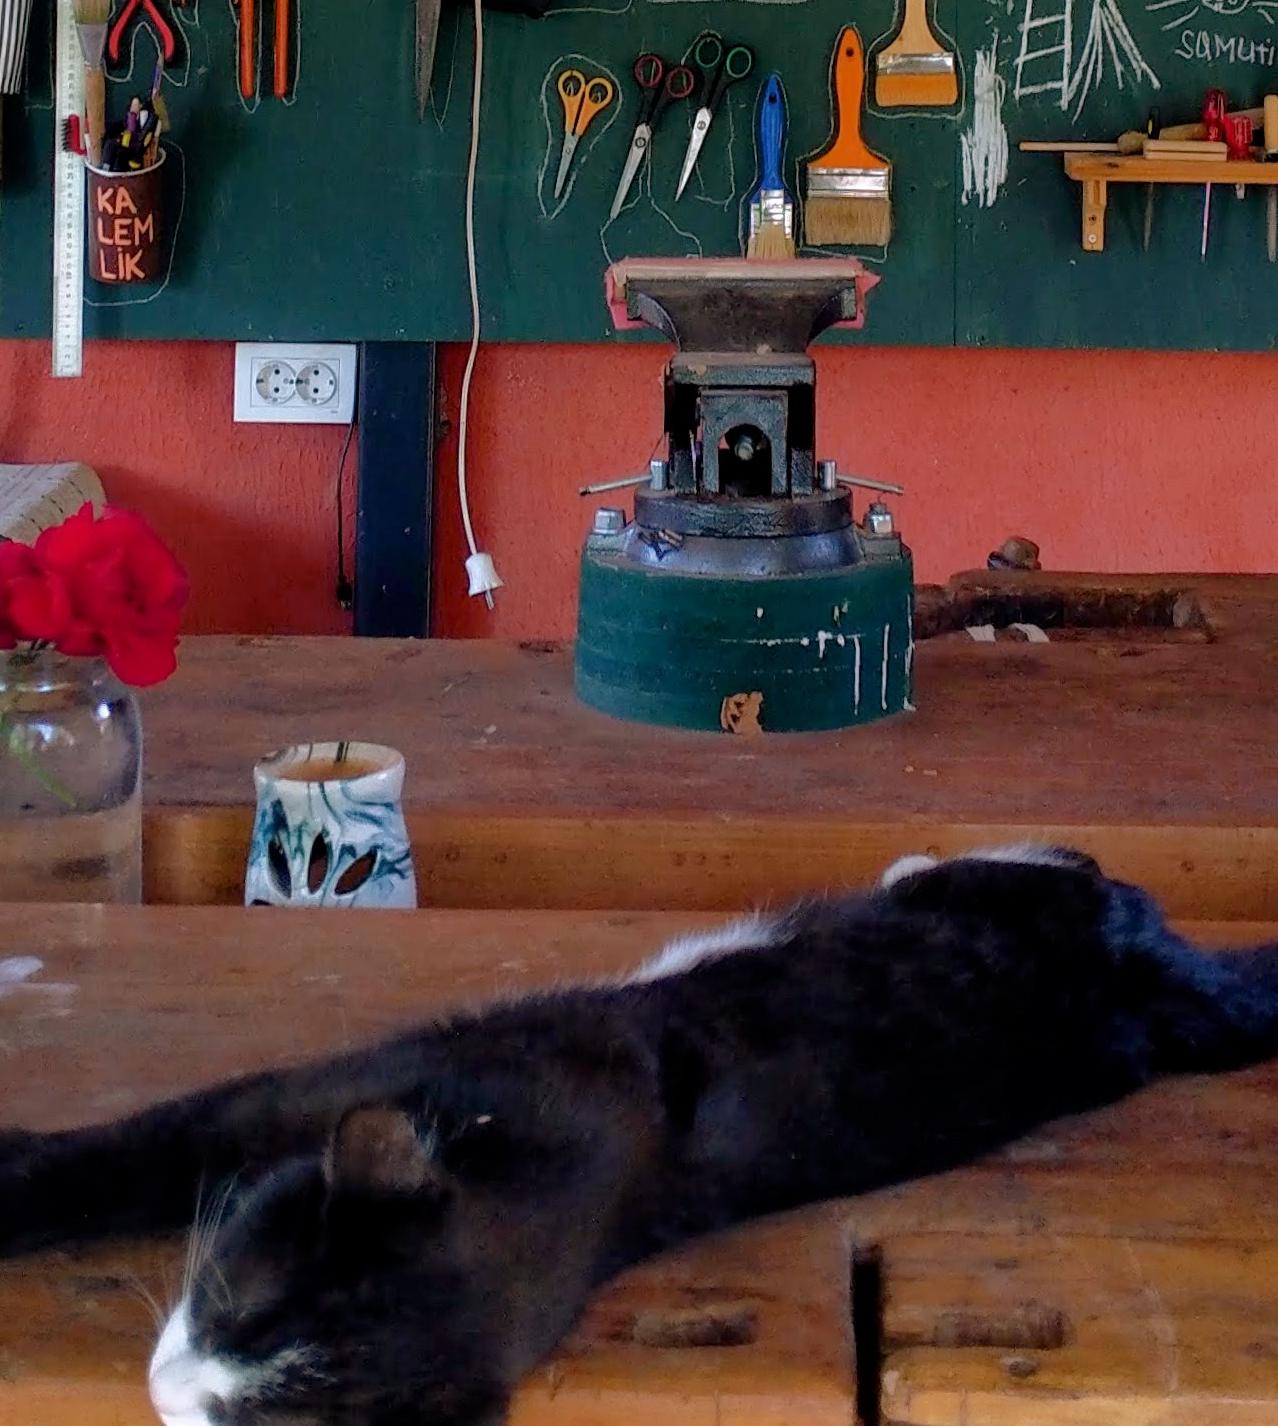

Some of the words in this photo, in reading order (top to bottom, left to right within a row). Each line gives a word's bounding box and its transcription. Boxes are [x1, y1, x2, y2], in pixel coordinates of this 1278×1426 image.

[96, 184, 139, 216] KA
[96, 210, 155, 247] LEM
[99, 246, 147, 281] LİK
